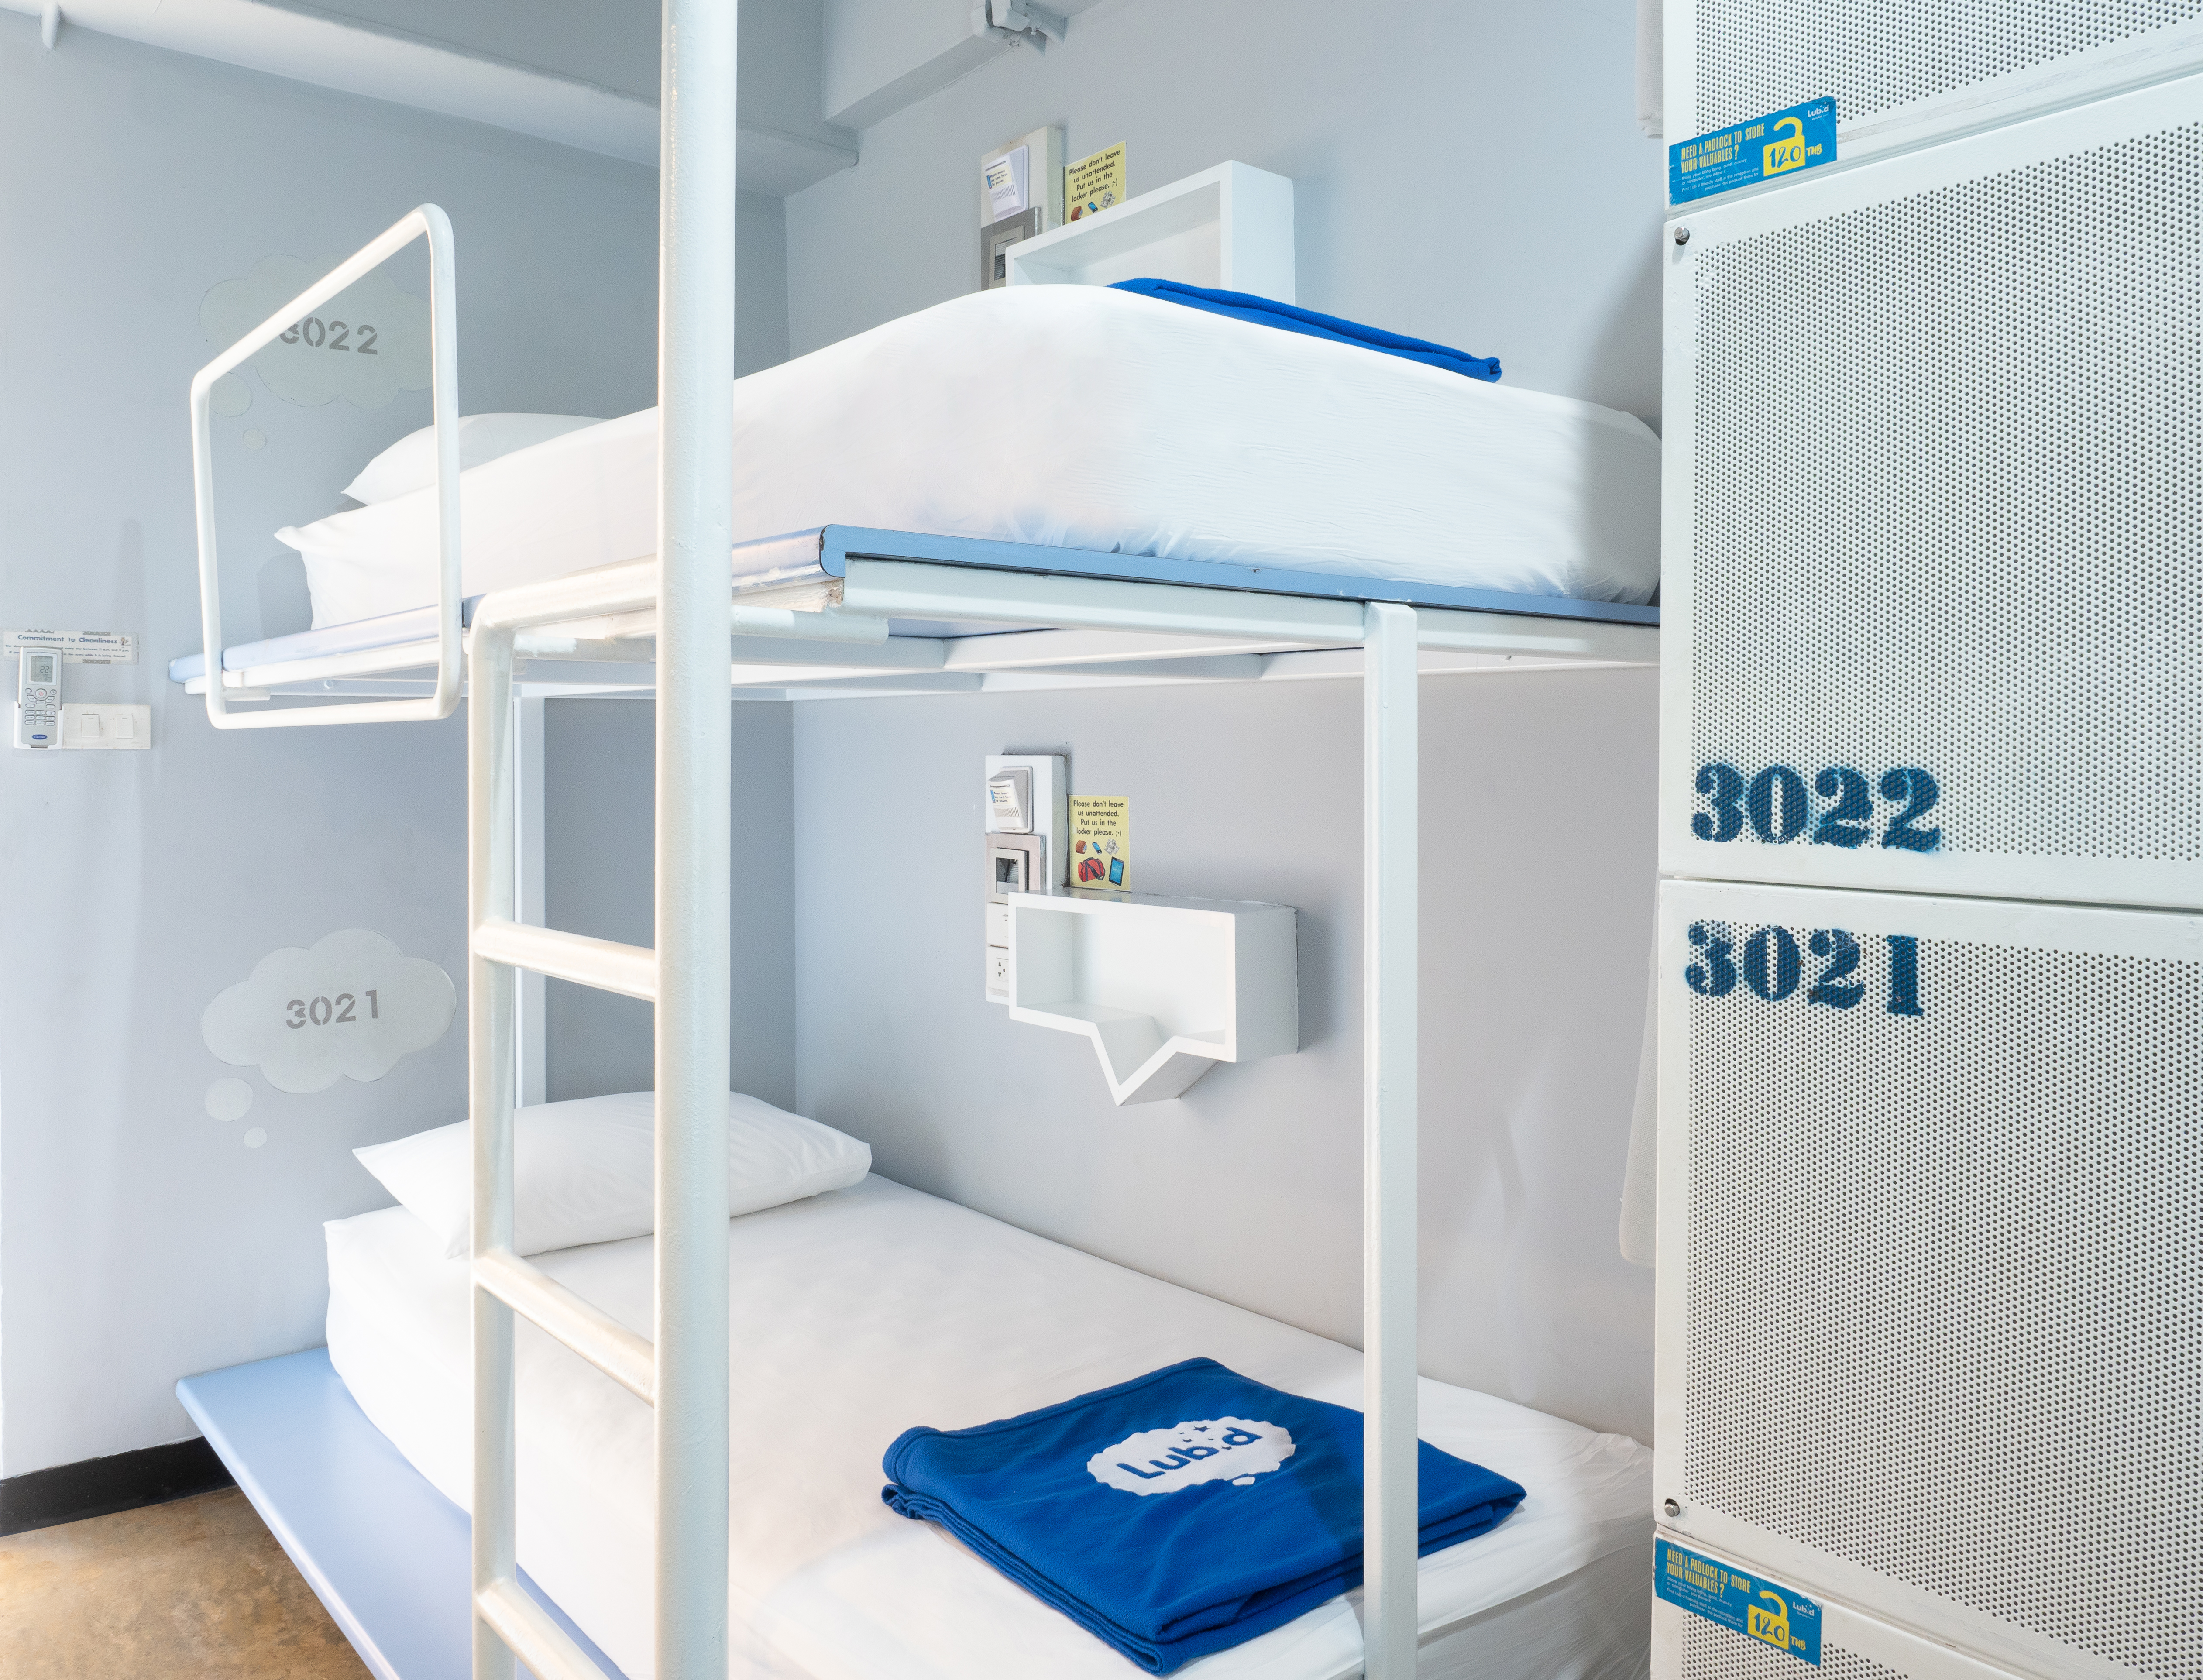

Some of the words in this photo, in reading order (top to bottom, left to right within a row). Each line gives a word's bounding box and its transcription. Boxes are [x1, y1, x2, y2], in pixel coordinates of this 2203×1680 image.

[1681, 144, 1697, 160] NEED
[1699, 143, 1702, 155] A
[1705, 133, 1732, 152] PADLOCK
[1734, 131, 1742, 144] TO
[1745, 123, 1765, 141] STORE
[1769, 145, 1801, 168] 120
[1806, 143, 1822, 156] THB
[1069, 165, 1086, 175] Please
[1089, 157, 1102, 167] don't
[1105, 150, 1120, 160] leave
[1082, 161, 1116, 180] unattended.
[1681, 158, 1697, 174] YOUR
[1699, 148, 1732, 168] VALUABLES
[1734, 144, 1739, 160] ?
[1072, 192, 1087, 202] locker
[1090, 184, 1110, 197] please.
[1076, 183, 1085, 191] Put
[279, 317, 378, 355] 3022
[40, 665, 49, 673] 22
[1691, 762, 1941, 853] 3022
[1094, 828, 1113, 837] please.
[1685, 919, 1924, 1017] 3021
[286, 989, 378, 1029] 3021
[1667, 1549, 1683, 1566] NEED
[1685, 1556, 1688, 1568] A
[1691, 1558, 1718, 1580] PADLOCK
[1720, 1570, 1728, 1584] TO
[1731, 1574, 1751, 1593] STORE
[1667, 1561, 1683, 1579] YOUR
[1685, 1570, 1718, 1594] VALUABLES
[1720, 1583, 1724, 1598] ?
[1754, 1612, 1785, 1642] 120
[1790, 1635, 1806, 1650] THB
